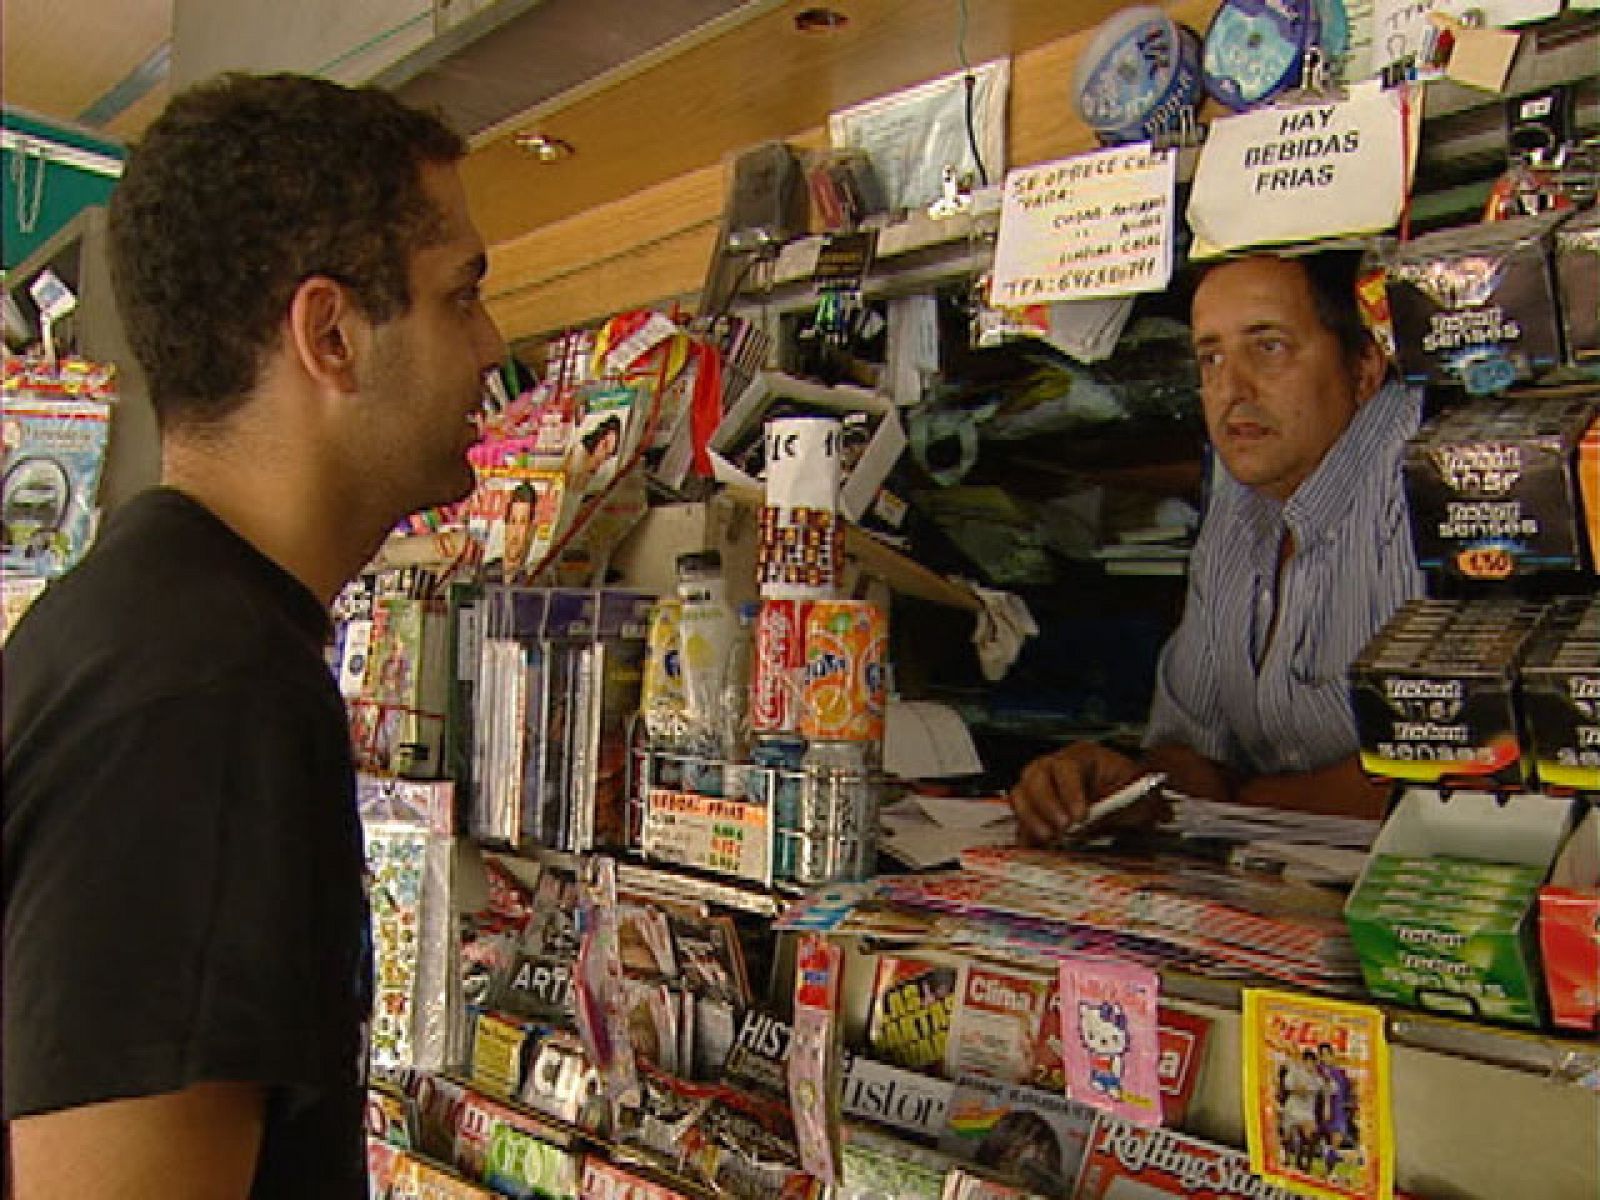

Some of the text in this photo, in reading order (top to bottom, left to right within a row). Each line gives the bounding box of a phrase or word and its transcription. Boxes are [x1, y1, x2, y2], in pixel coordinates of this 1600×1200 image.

[1279, 105, 1336, 136] HAY
[1244, 130, 1360, 170] BEBIDAS
[1254, 164, 1336, 194] FRIAS
[1098, 1115, 1211, 1189] Rolling
